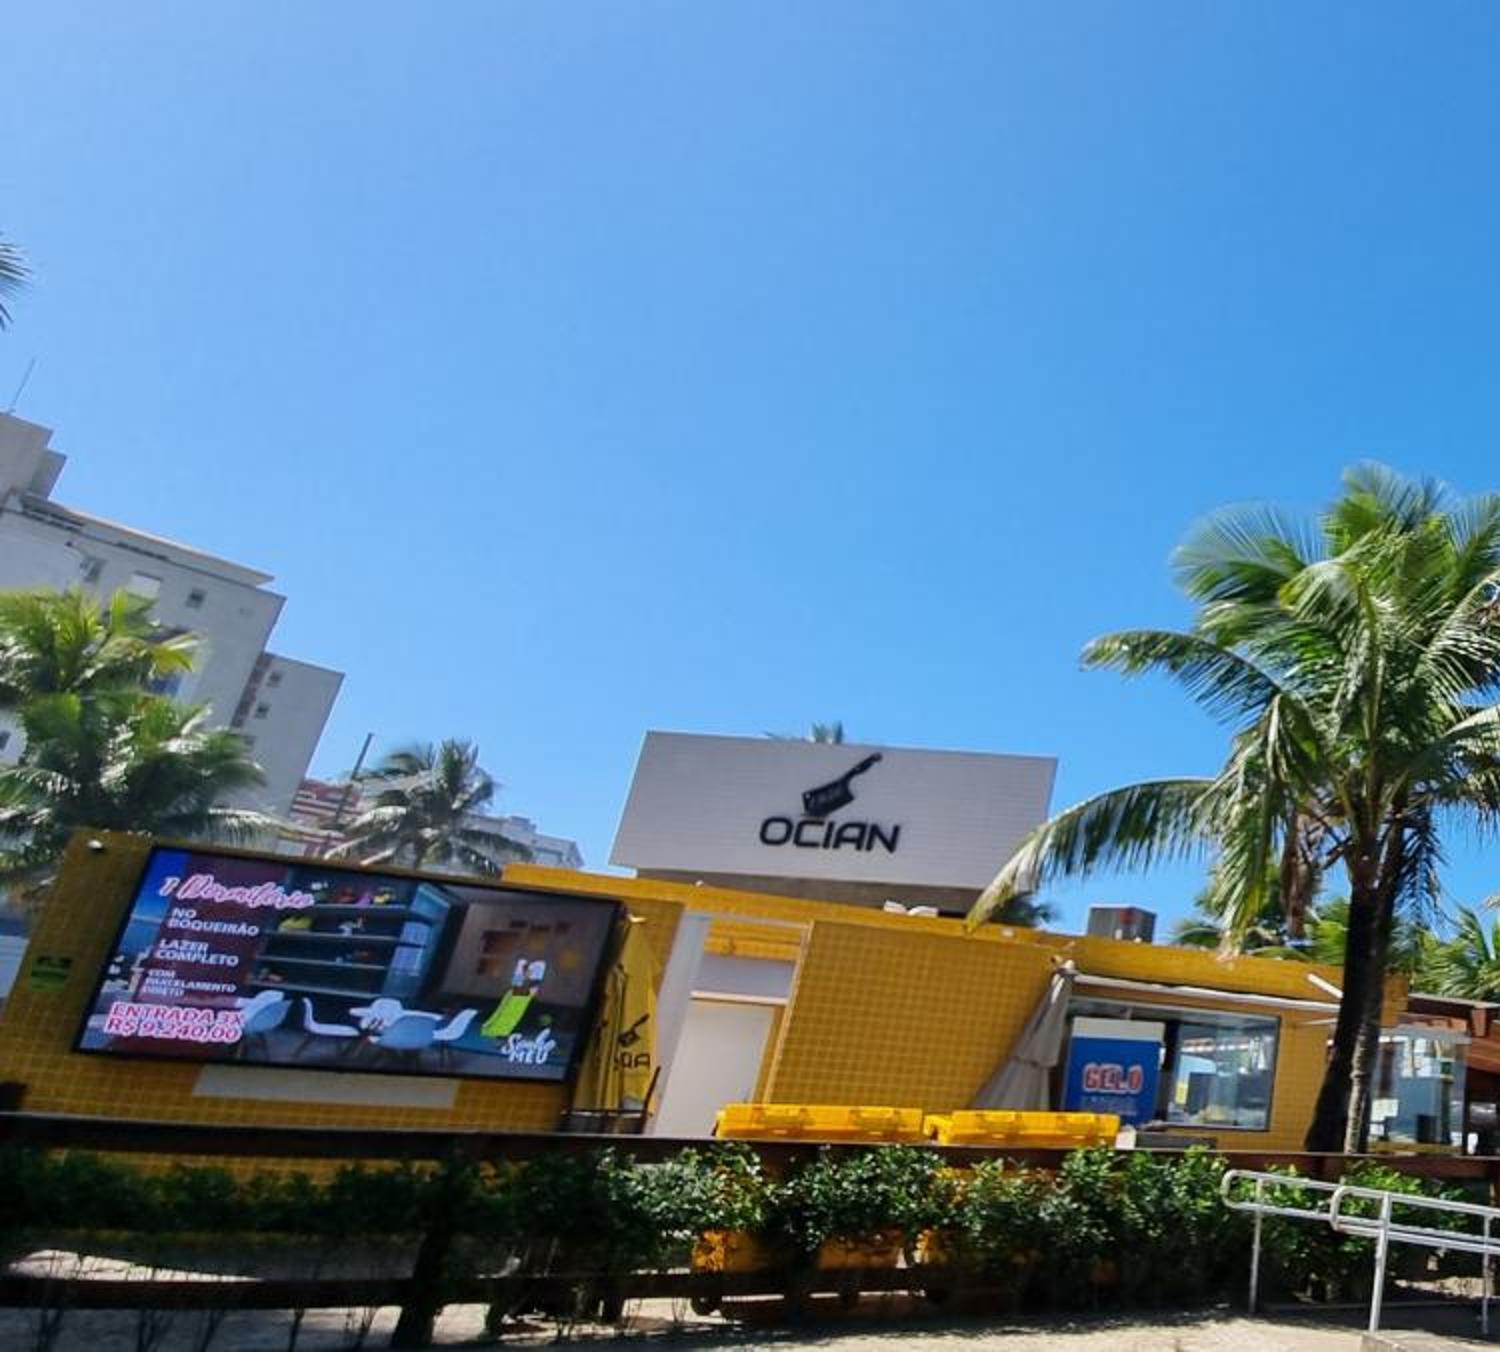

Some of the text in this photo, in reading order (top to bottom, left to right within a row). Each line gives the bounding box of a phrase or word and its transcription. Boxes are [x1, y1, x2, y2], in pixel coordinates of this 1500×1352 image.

[760, 817, 900, 853] OCIAN
[171, 907, 197, 919] NO
[167, 917, 259, 937] BOQUEIRÃO
[158, 938, 208, 952] LAZER
[154, 949, 239, 967] COMPLETO
[149, 968, 176, 979] COM
[111, 1001, 214, 1026] ENTRADA
[104, 1016, 138, 1036] R$
[508, 1049, 550, 1065] MEU
[1083, 1063, 1143, 1095] GELO
